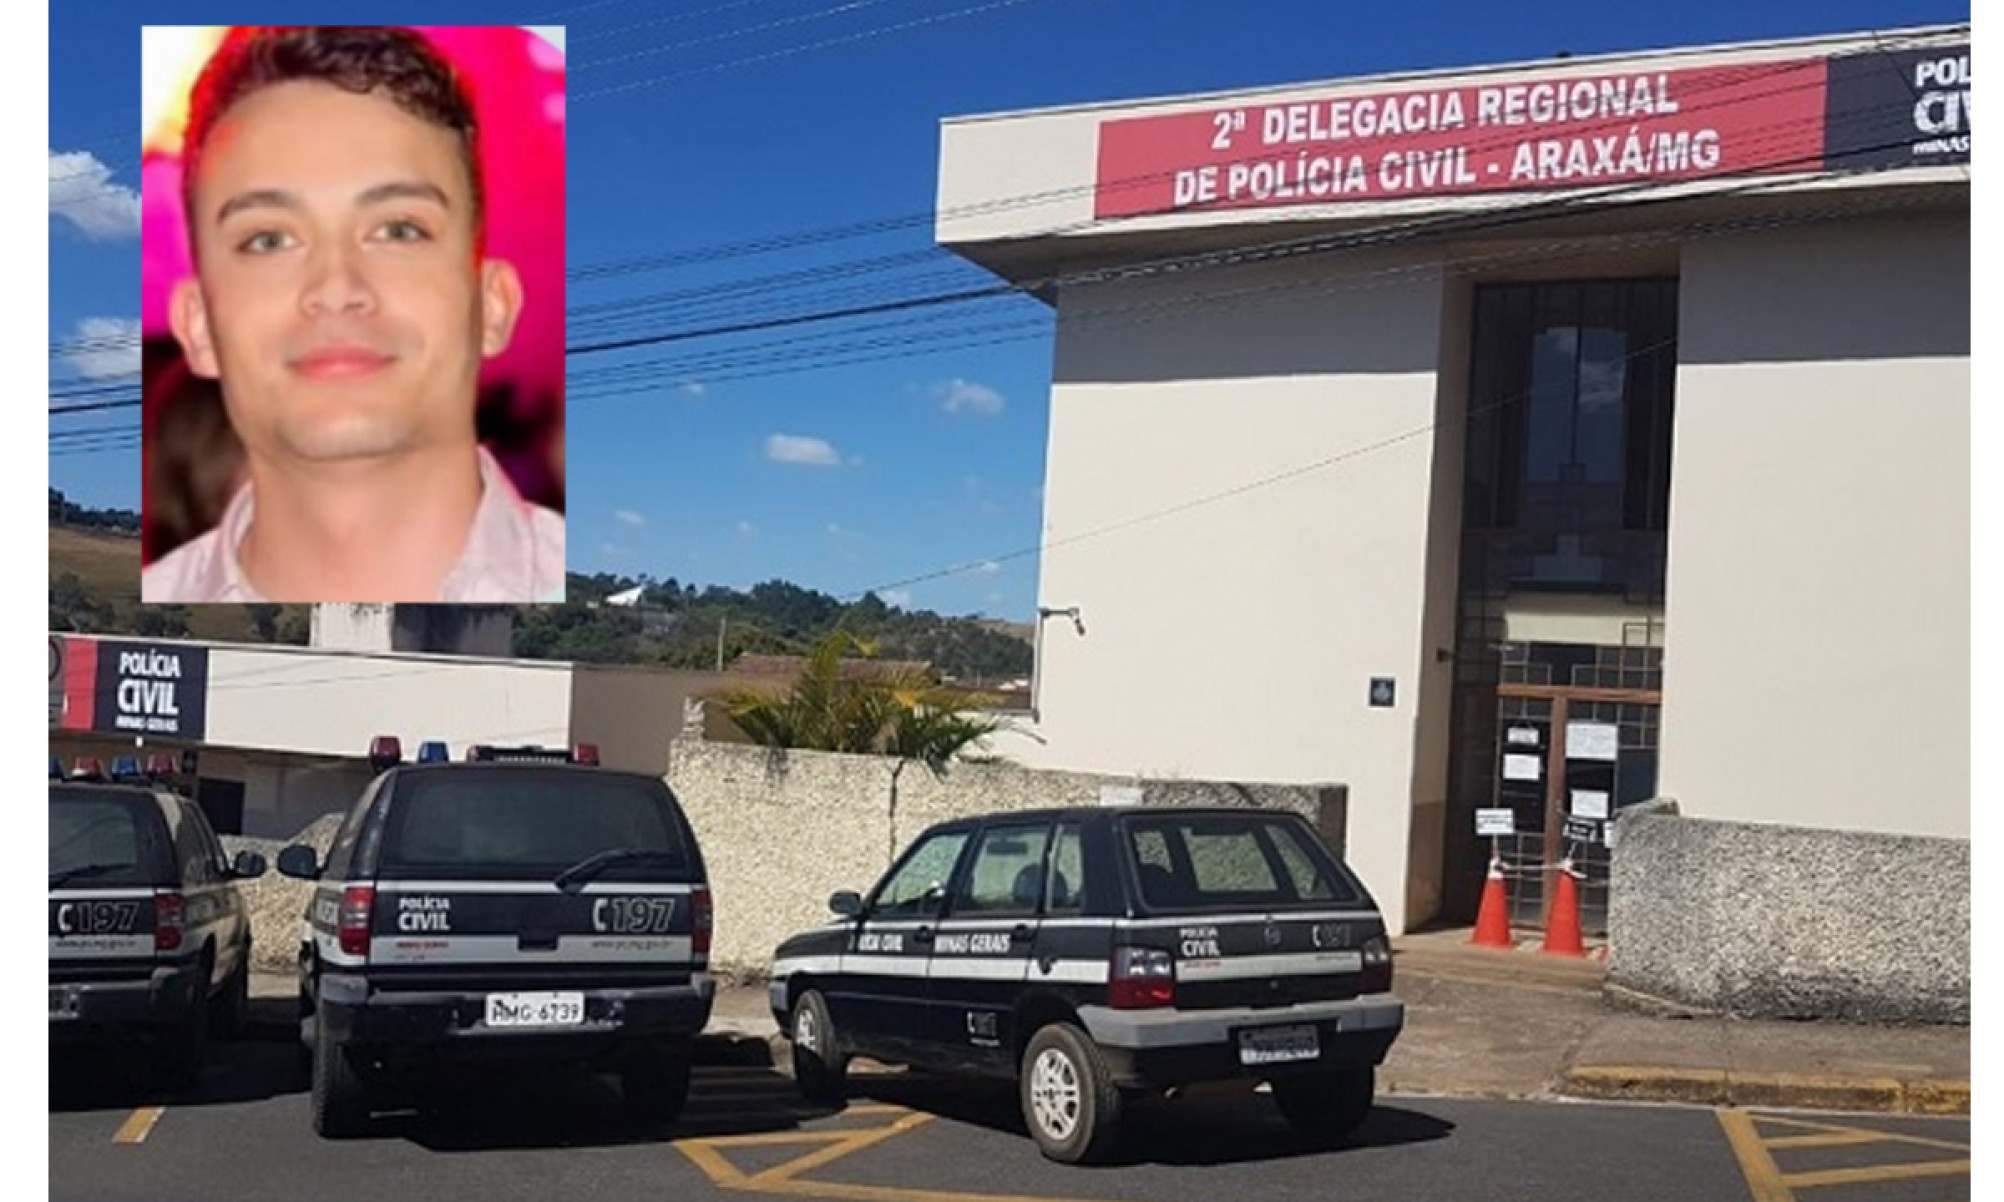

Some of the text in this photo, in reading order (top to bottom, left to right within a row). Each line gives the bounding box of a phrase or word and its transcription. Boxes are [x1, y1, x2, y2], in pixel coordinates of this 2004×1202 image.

[1212, 73, 1679, 149] 2ª DELEGACIA REGIONAL
[1174, 124, 1721, 206] DE POLÍCIA CIVIL - ARAXÁ/MG
[119, 649, 181, 677] POLÍCIA
[117, 678, 178, 715] CIVIL
[399, 911, 451, 931] CIVIL
[611, 897, 675, 932] 197
